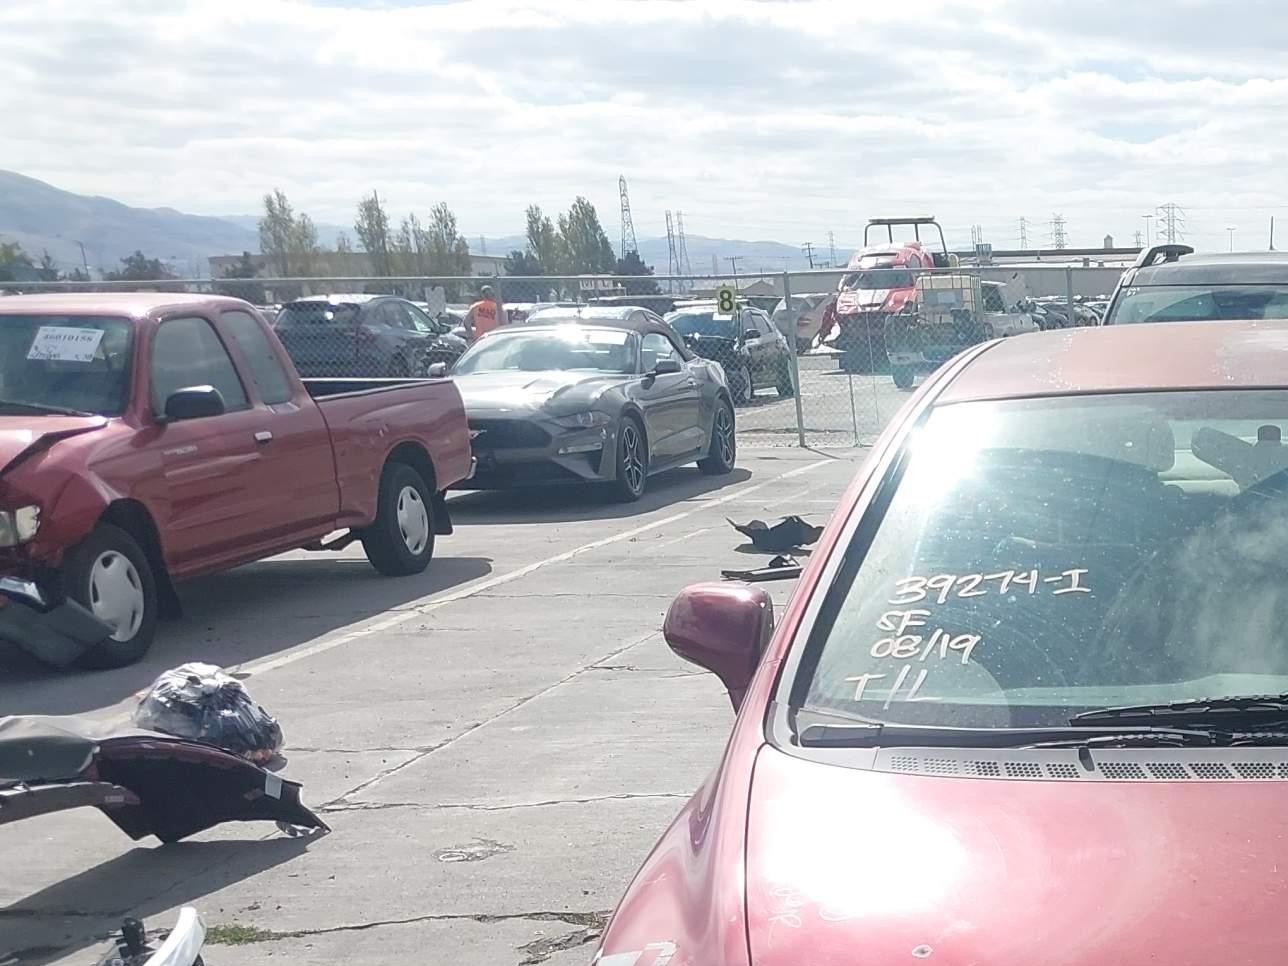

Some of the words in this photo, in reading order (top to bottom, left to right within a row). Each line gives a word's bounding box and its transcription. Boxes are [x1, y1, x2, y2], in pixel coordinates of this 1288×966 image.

[719, 290, 732, 310] 8
[889, 569, 1092, 604] 39274-I
[876, 610, 931, 635] SF
[870, 628, 982, 664] 08/19
